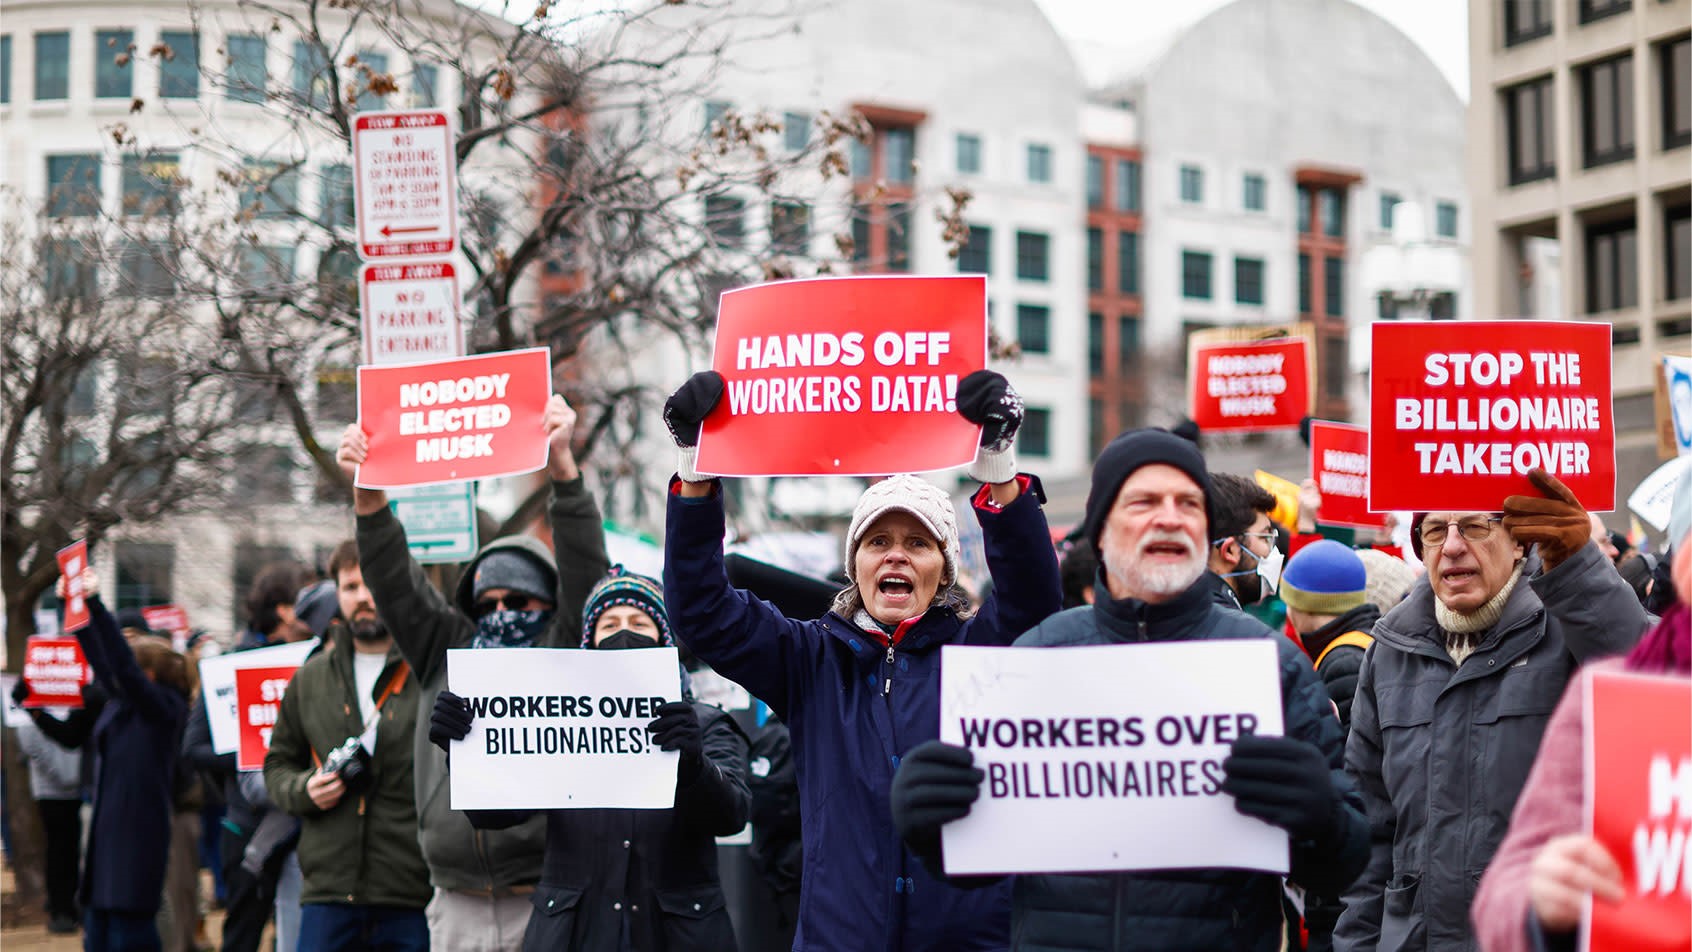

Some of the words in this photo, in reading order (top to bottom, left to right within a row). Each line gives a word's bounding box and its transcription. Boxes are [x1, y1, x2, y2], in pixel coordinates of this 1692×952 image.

[371, 149, 438, 164] STANDING
[397, 290, 424, 304] NO
[377, 310, 446, 327] PARKING
[377, 334, 448, 354] ENTRANCE
[737, 332, 865, 371] HANDS
[873, 331, 950, 366] OFF
[1207, 352, 1285, 375] NOBODY
[1424, 352, 1524, 386] STOP
[1530, 352, 1581, 385] THE
[400, 373, 511, 408] NOBODY
[727, 376, 862, 416] WORKERS
[871, 374, 959, 414] DATA!
[1207, 373, 1287, 398] ELECTED
[400, 404, 511, 435] ELECTED
[1219, 396, 1277, 418] MUSK
[1395, 397, 1600, 431] BILLIONAIRE
[416, 433, 494, 463] MUSK
[1414, 442, 1591, 475] TAKEOVER
[260, 679, 289, 702] ST
[463, 695, 594, 719] WORKERS
[598, 696, 667, 719] OVER
[485, 726, 651, 755] BILLIONAIRES!
[960, 717, 1145, 748] WORKERS
[1155, 713, 1258, 746] OVER
